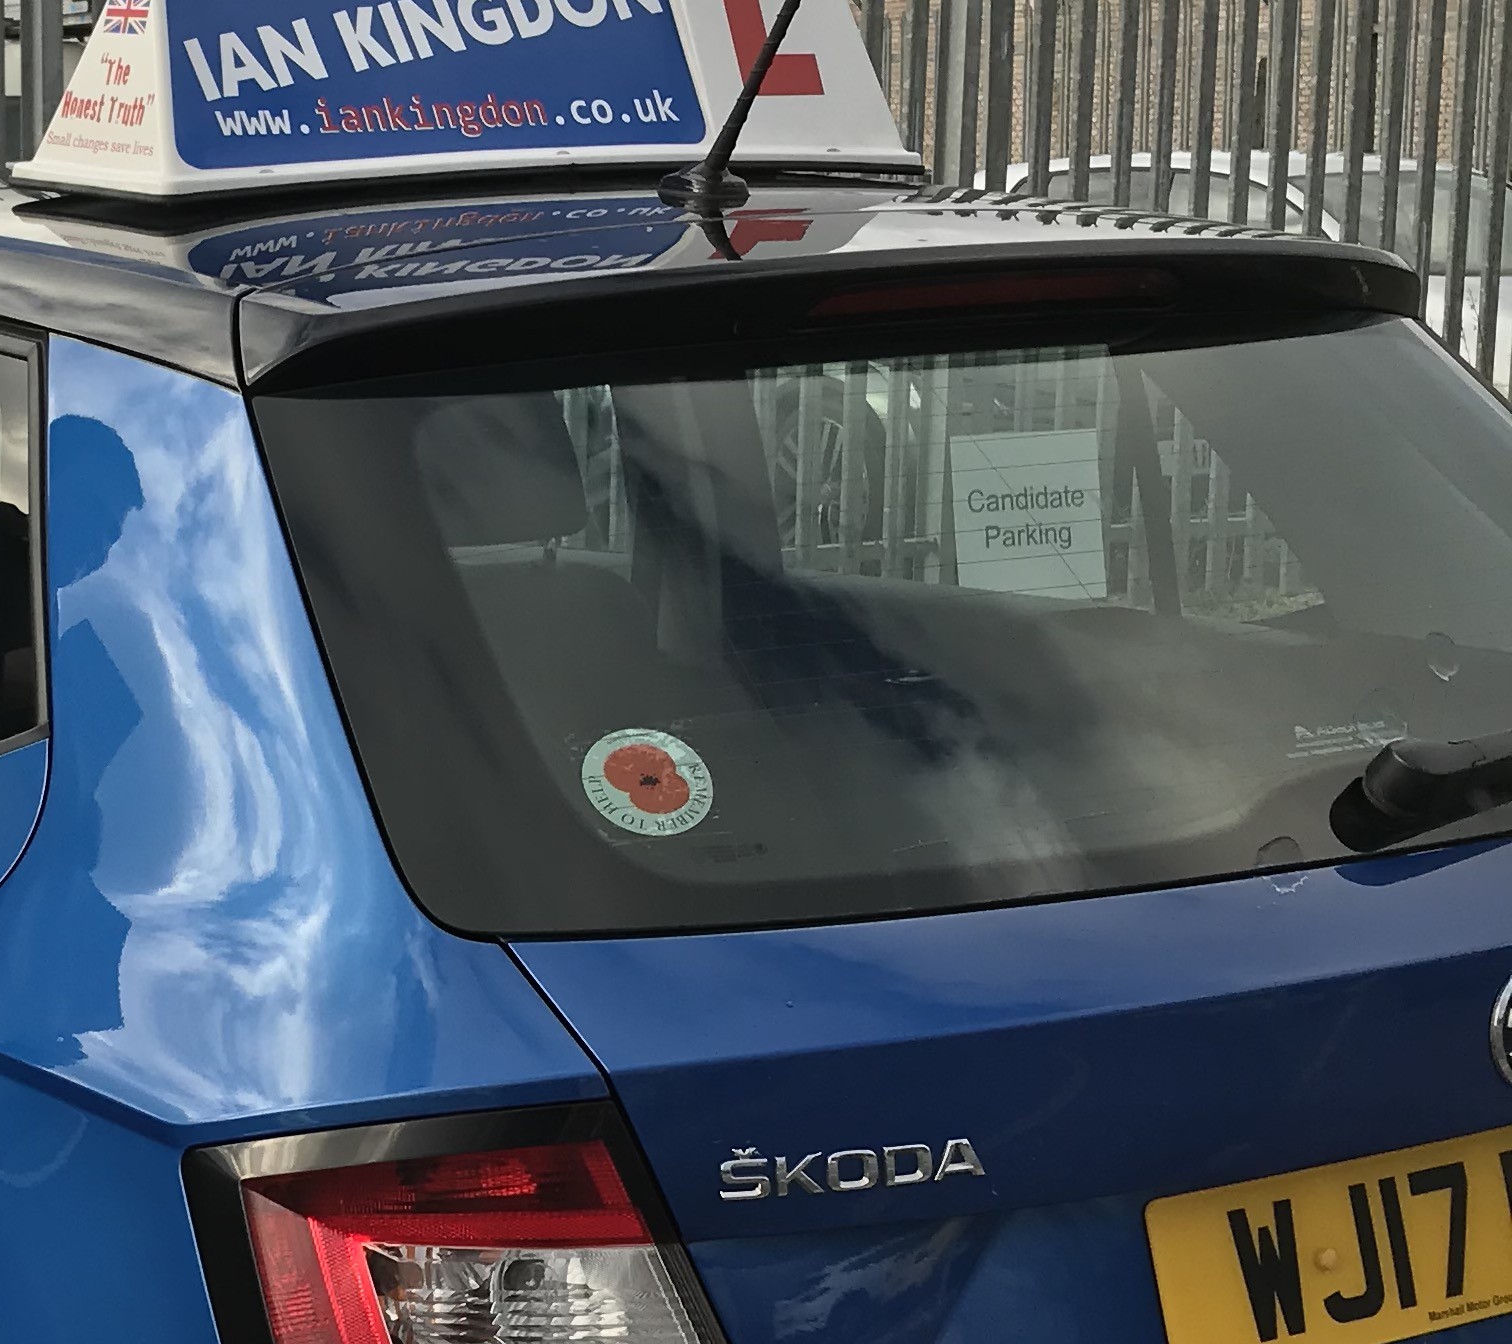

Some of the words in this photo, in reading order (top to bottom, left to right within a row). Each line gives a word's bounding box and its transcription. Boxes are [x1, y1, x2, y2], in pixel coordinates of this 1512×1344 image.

[183, 17, 329, 102] IAN
[61, 90, 105, 123] Honest
[214, 88, 680, 138] www.iankingdon.co.uk
[46, 130, 73, 147] Small
[73, 135, 109, 154] changes
[110, 142, 131, 154] save
[132, 140, 154, 156] lives
[967, 485, 1085, 513] Candidate
[984, 522, 1072, 550] Parking
[719, 1138, 986, 1201] ŠKODA
